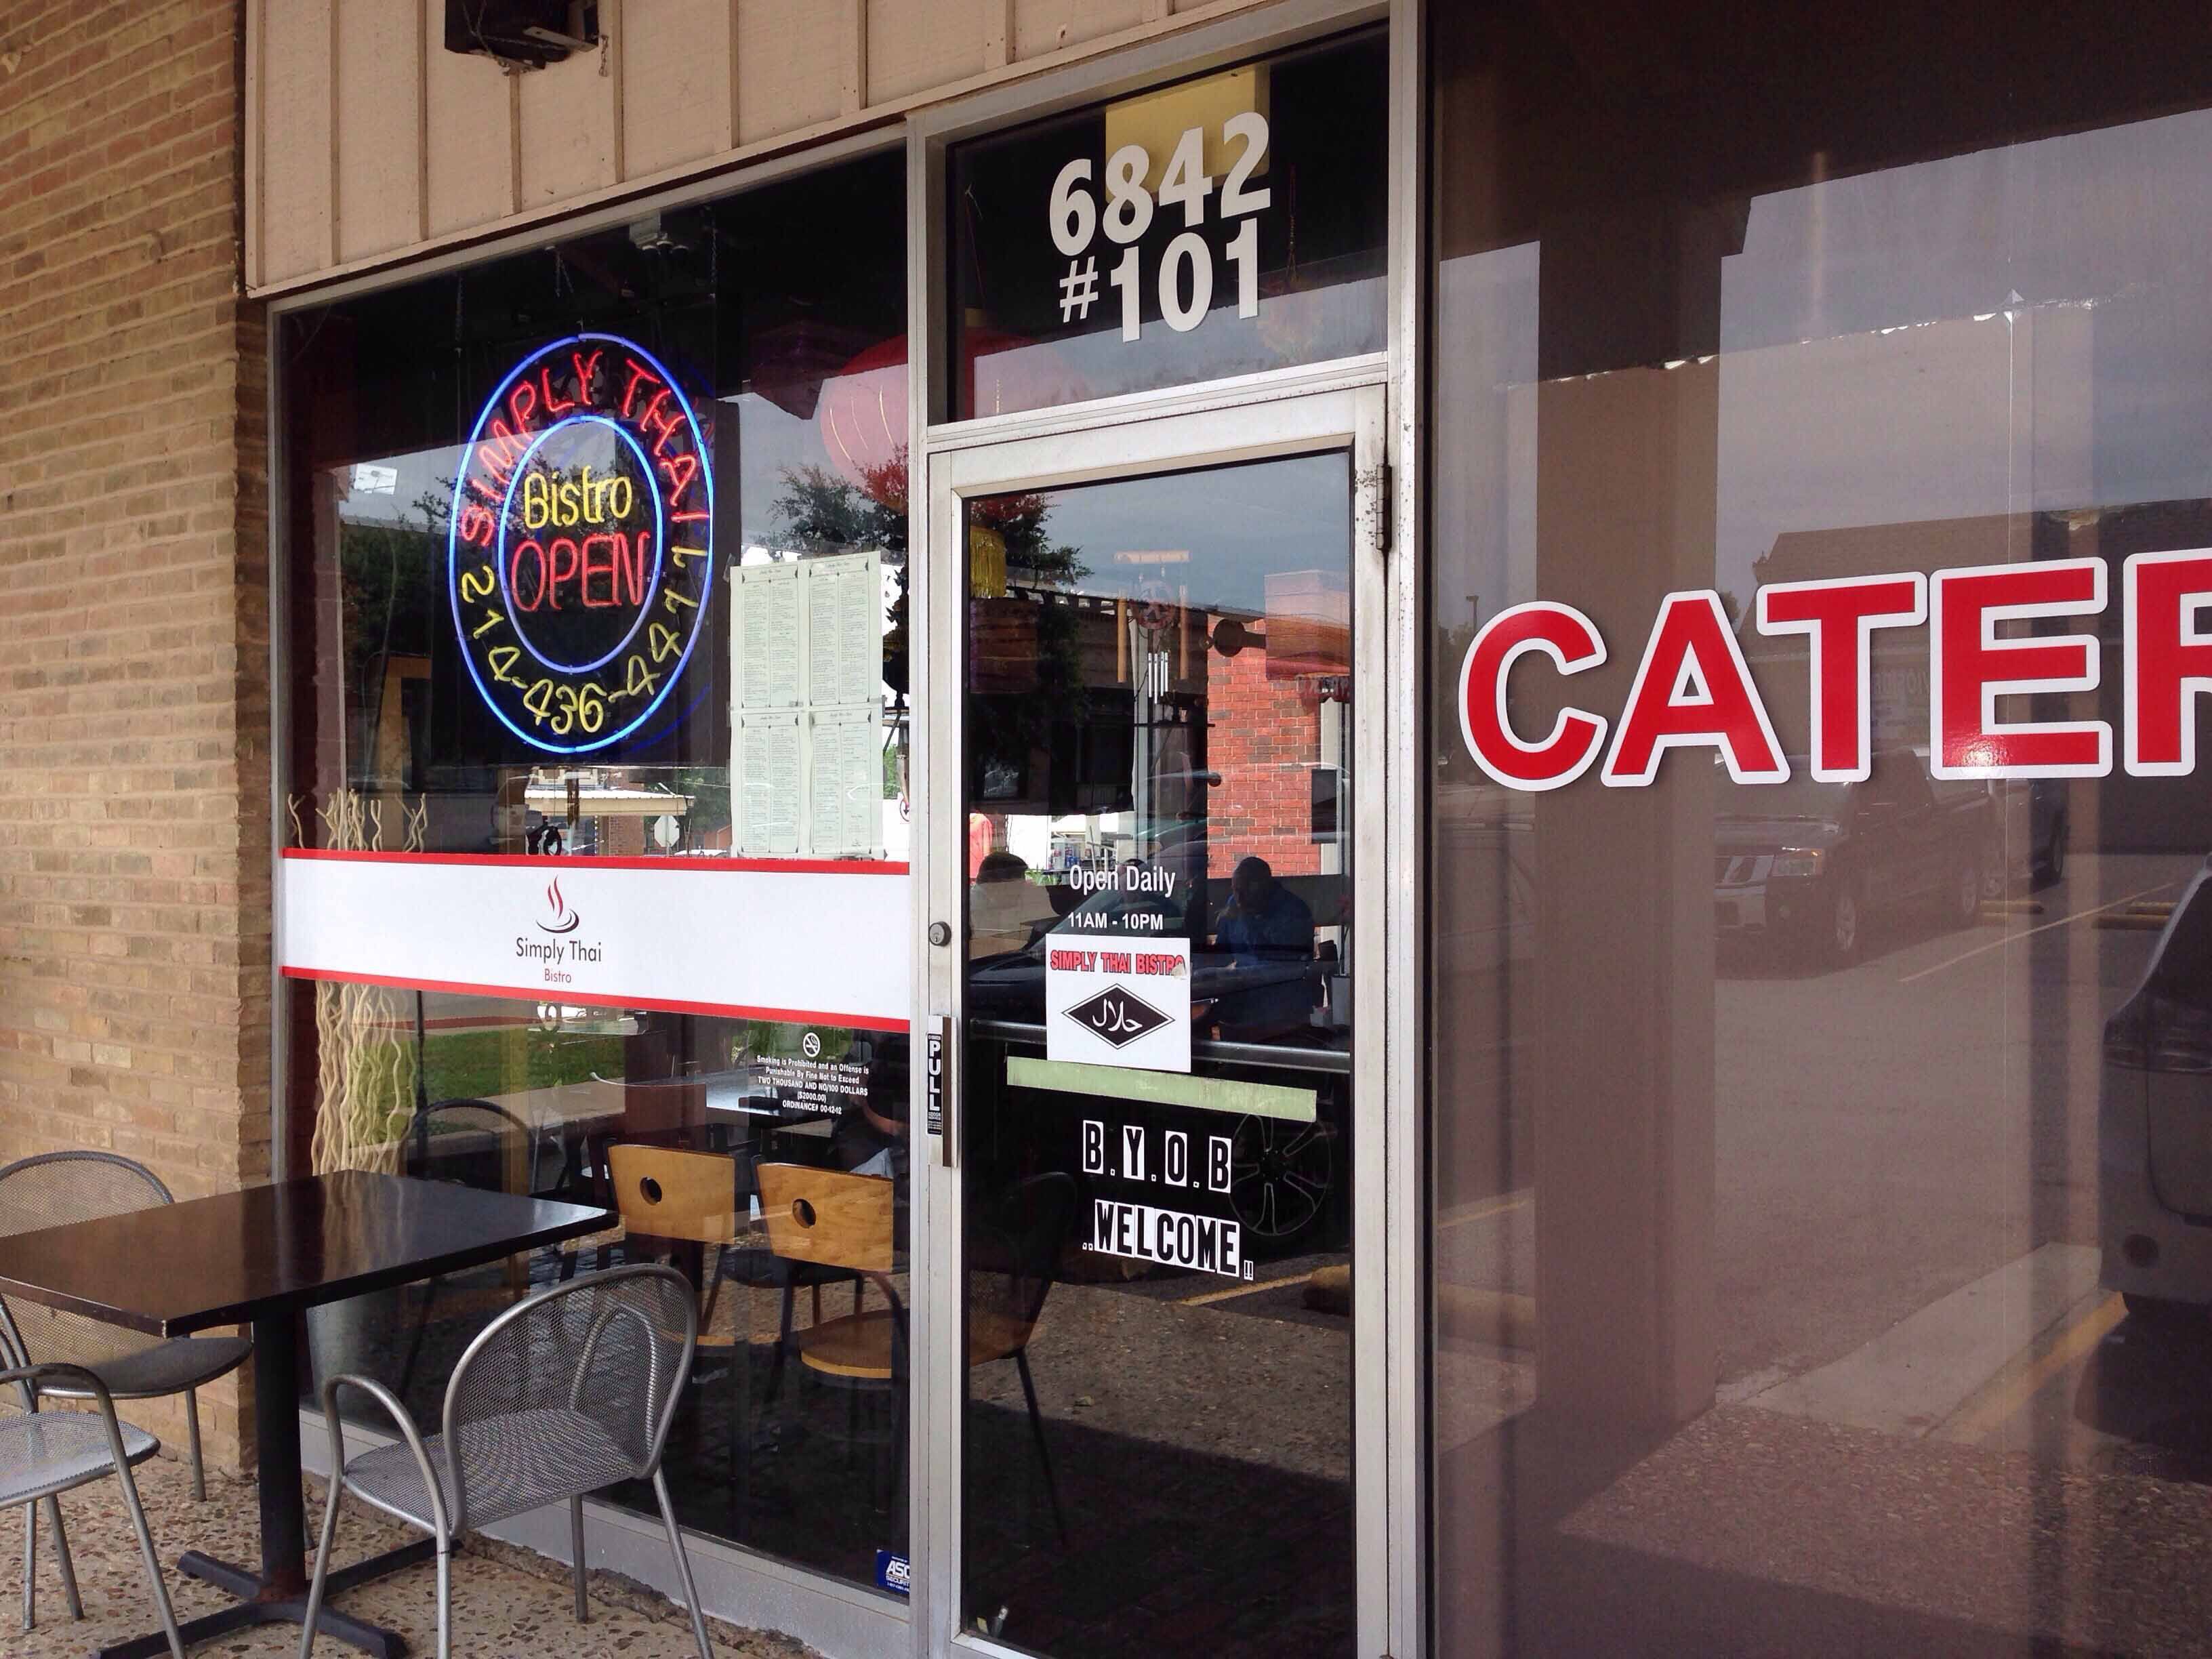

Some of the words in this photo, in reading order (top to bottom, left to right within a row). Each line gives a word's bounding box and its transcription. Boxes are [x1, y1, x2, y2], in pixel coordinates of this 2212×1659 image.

[1049, 111, 1271, 256] 6842
[1059, 217, 1258, 342] #101
[461, 350, 603, 547] SIMPLY
[622, 359, 710, 523] THAI
[524, 466, 632, 529] Bistro
[510, 531, 651, 612] OPEN
[1069, 864, 1118, 895] Open
[1126, 865, 1176, 898] Daily
[1067, 912, 1107, 928] 11AM
[1122, 913, 1164, 930] 10PM
[516, 937, 565, 965] Simply
[569, 939, 602, 962] Thai
[1050, 949, 1098, 972] SIMPLY
[1101, 951, 1132, 974] THAI
[544, 968, 572, 983] Bistro
[1092, 998, 1143, 1033] حلال
[756, 1055, 780, 1067] Smoking
[781, 1057, 787, 1065] is
[788, 1058, 817, 1069] Prohibited
[839, 1063, 862, 1073] Offense
[863, 1066, 869, 1074] is
[765, 1067, 796, 1076] Punishable
[797, 1069, 804, 1080] By
[805, 1071, 817, 1080] Fine
[819, 1073, 830, 1081] Not
[831, 1073, 837, 1082] to
[838, 1075, 860, 1084] Exceed
[928, 1040, 941, 1111] PULL
[758, 1076, 771, 1085] TWO
[773, 1078, 803, 1088] THOUSAND
[804, 1080, 817, 1090] AND
[819, 1082, 838, 1092] NO/100
[840, 1084, 868, 1097] DOLLARS
